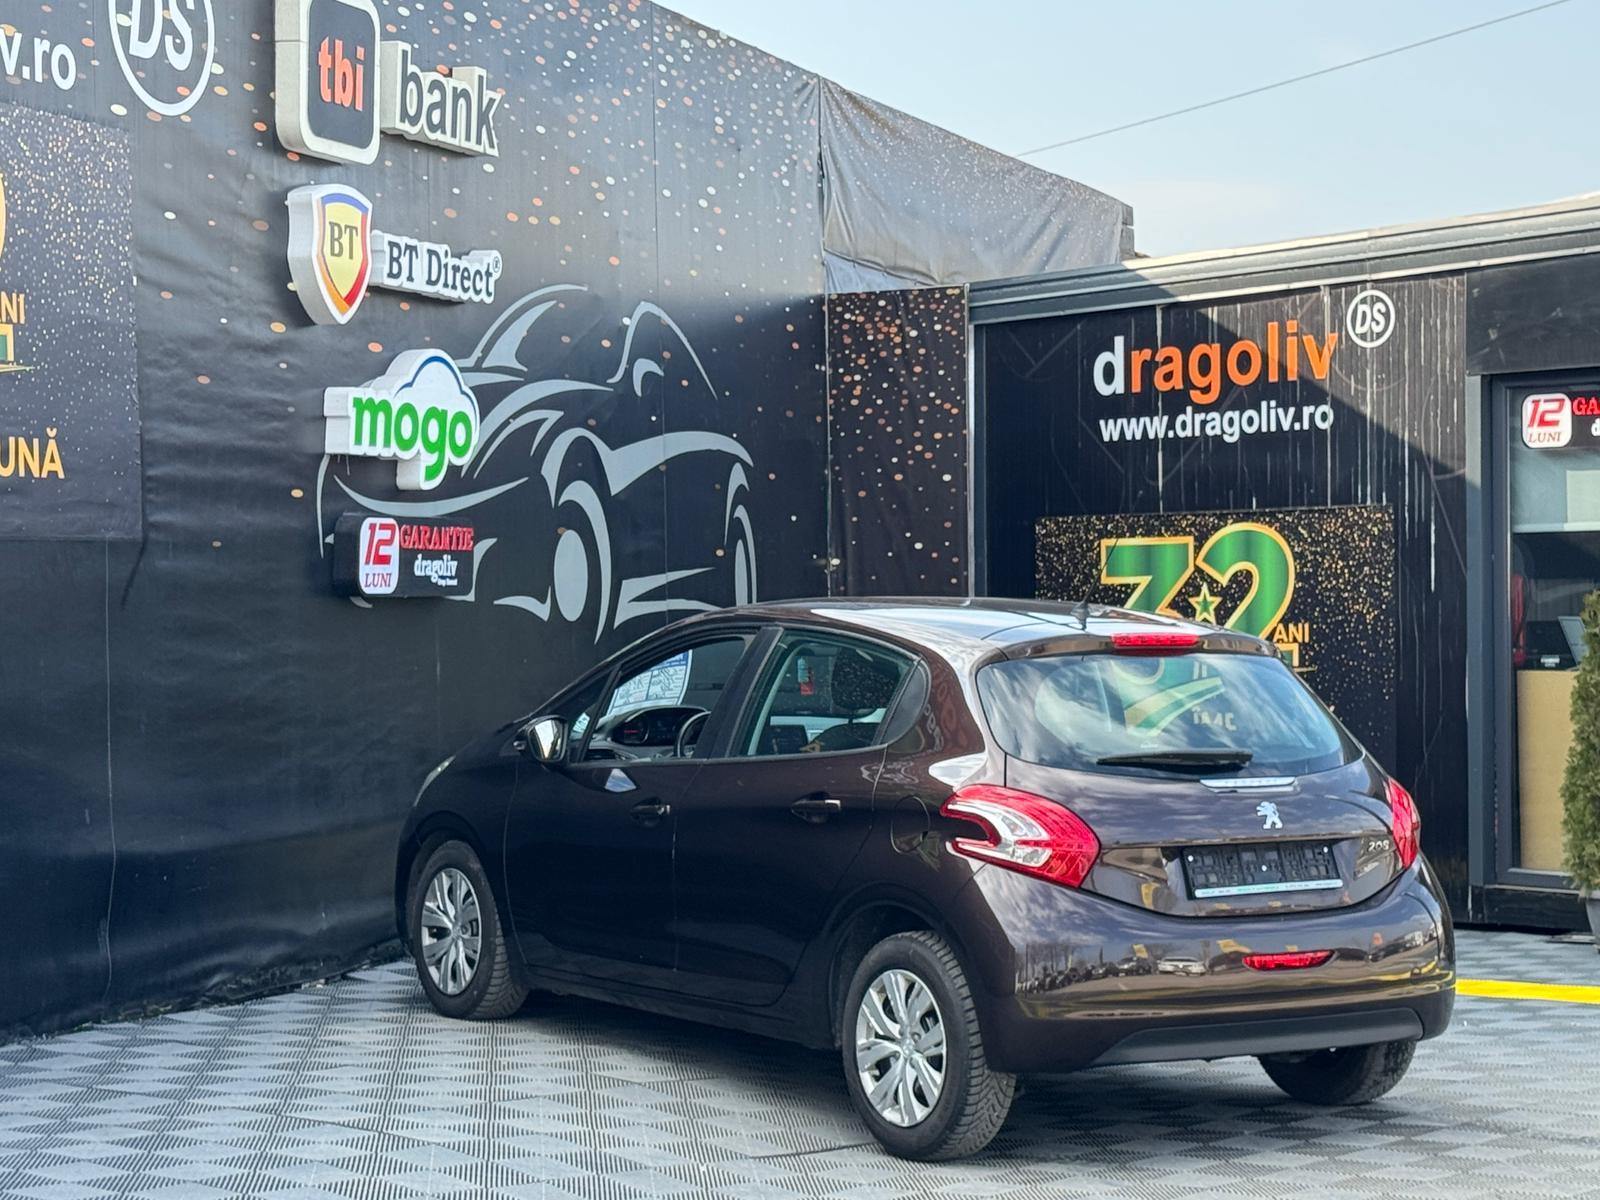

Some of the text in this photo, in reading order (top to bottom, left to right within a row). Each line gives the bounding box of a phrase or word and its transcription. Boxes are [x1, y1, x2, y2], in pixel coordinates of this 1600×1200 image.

[318, 36, 497, 150] tbi bank
[329, 221, 359, 260] BT
[387, 240, 418, 283] BT
[0, 290, 25, 325] NI
[1355, 303, 1387, 334] DS
[1093, 320, 1339, 404] dragoliv
[1099, 400, 1334, 443] www.dragoliv.ro
[1528, 398, 1566, 427] 12
[353, 396, 472, 482] mogo
[1529, 432, 1562, 443] LUNI
[364, 522, 474, 566] 12 GARANTIE
[364, 572, 391, 588] LUNI
[413, 553, 458, 583] dragoliv
[1273, 622, 1310, 643] ANI
